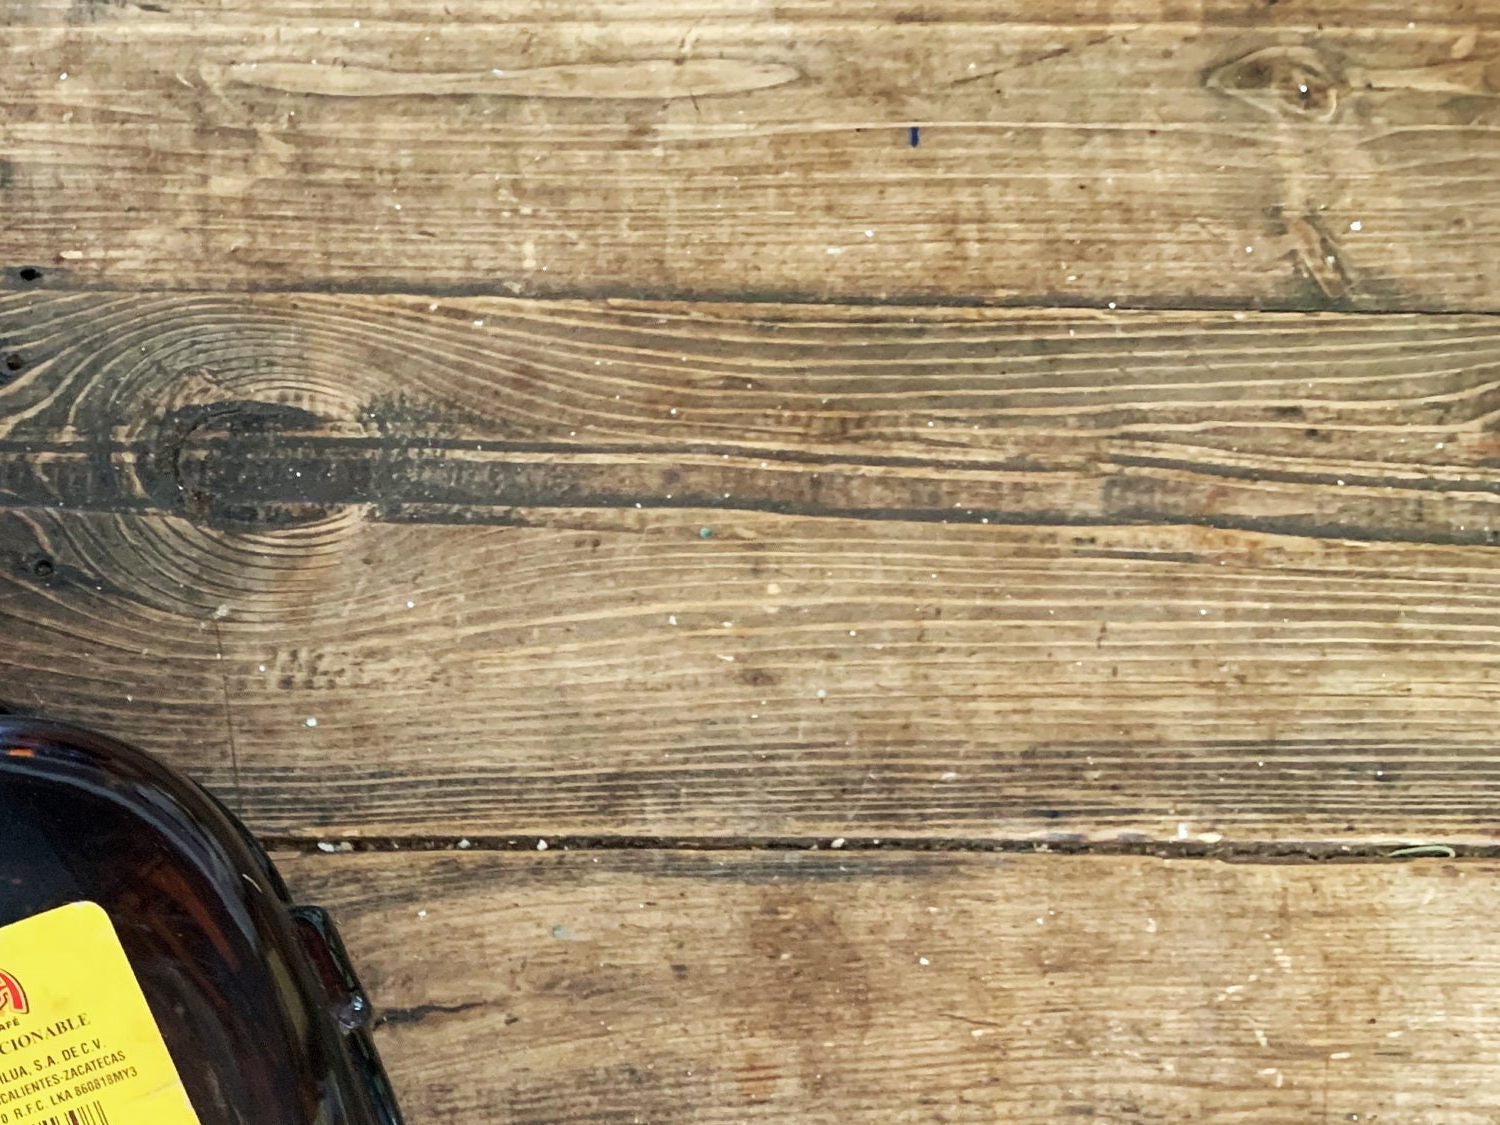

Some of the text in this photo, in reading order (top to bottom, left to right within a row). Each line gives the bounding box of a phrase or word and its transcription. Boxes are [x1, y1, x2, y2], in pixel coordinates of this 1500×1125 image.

[34, 1055, 60, 1072] S.A.
[61, 1046, 79, 1062] DE
[14, 1100, 49, 1120] R.F.C.
[50, 1089, 73, 1106] LKA
